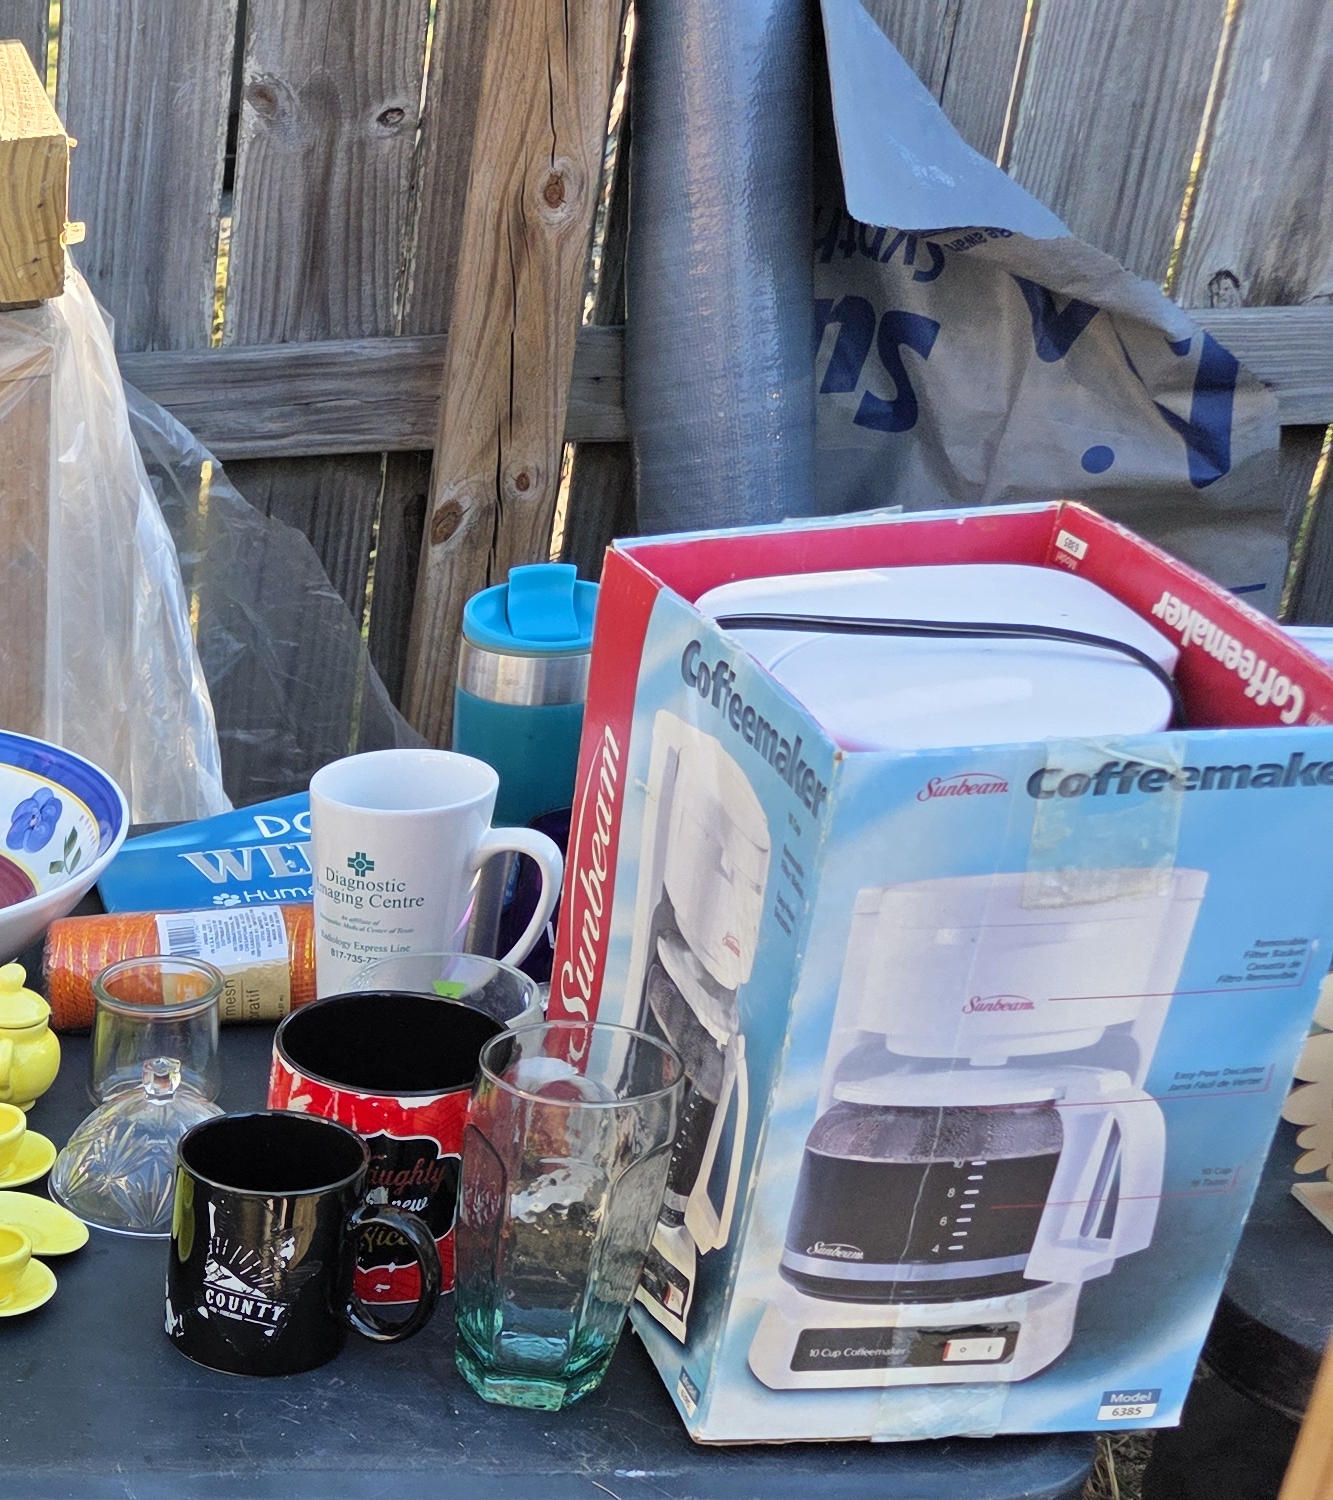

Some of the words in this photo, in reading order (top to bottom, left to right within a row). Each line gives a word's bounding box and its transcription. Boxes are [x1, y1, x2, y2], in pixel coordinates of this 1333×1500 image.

[1151, 591, 1306, 724] Coffeemaker
[681, 639, 828, 819] Coffeemaker
[916, 772, 1010, 803] Sunbeam
[326, 867, 406, 893] Diagnostic
[369, 894, 425, 909] Centre
[560, 724, 620, 1062] Sunbeam
[331, 948, 378, 963] 817-735-7
[354, 941, 387, 953] Express
[390, 944, 411, 953] Line
[961, 994, 1035, 1015] Sunbeam
[946, 1187, 956, 1198] 8
[939, 1216, 948, 1226] 6
[806, 1241, 864, 1260] Sunbeam
[205, 1289, 286, 1322] COUNTY
[808, 1349, 820, 1357] 10
[821, 1348, 841, 1358] Cup
[843, 1347, 906, 1358] Coffeemaker
[1110, 1392, 1152, 1403] Model
[1111, 1407, 1142, 1417] 6385
